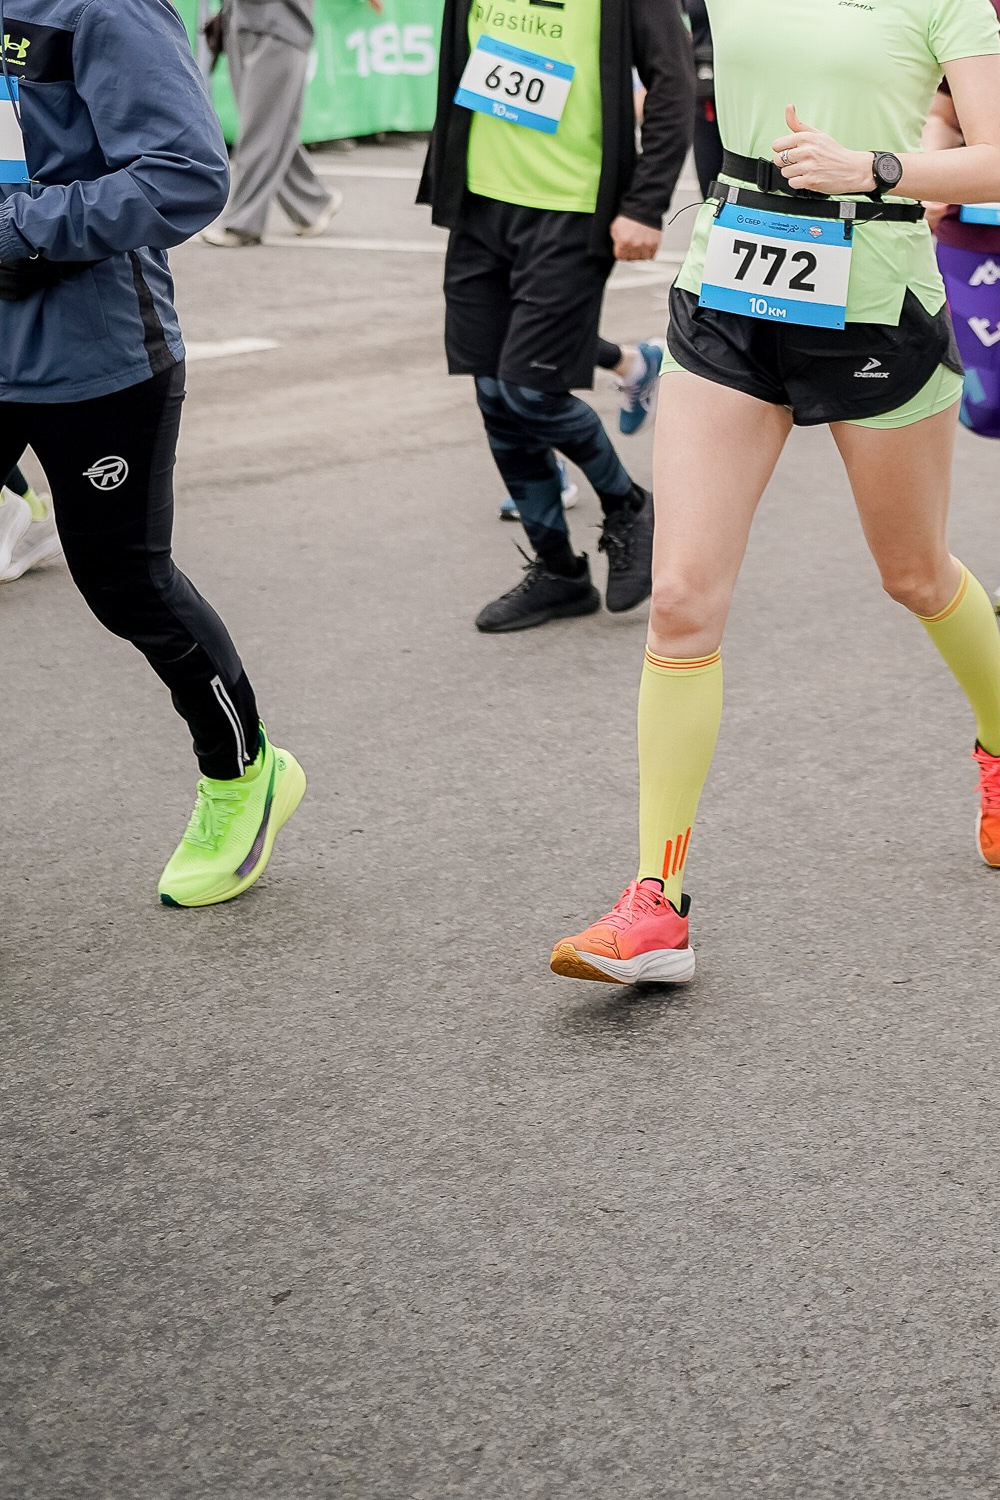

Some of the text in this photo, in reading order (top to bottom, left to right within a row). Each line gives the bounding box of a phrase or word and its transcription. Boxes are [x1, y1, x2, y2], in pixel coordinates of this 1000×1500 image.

[485, 65, 545, 103] 630
[732, 239, 818, 292] 772
[853, 371, 890, 379] DEMIX
